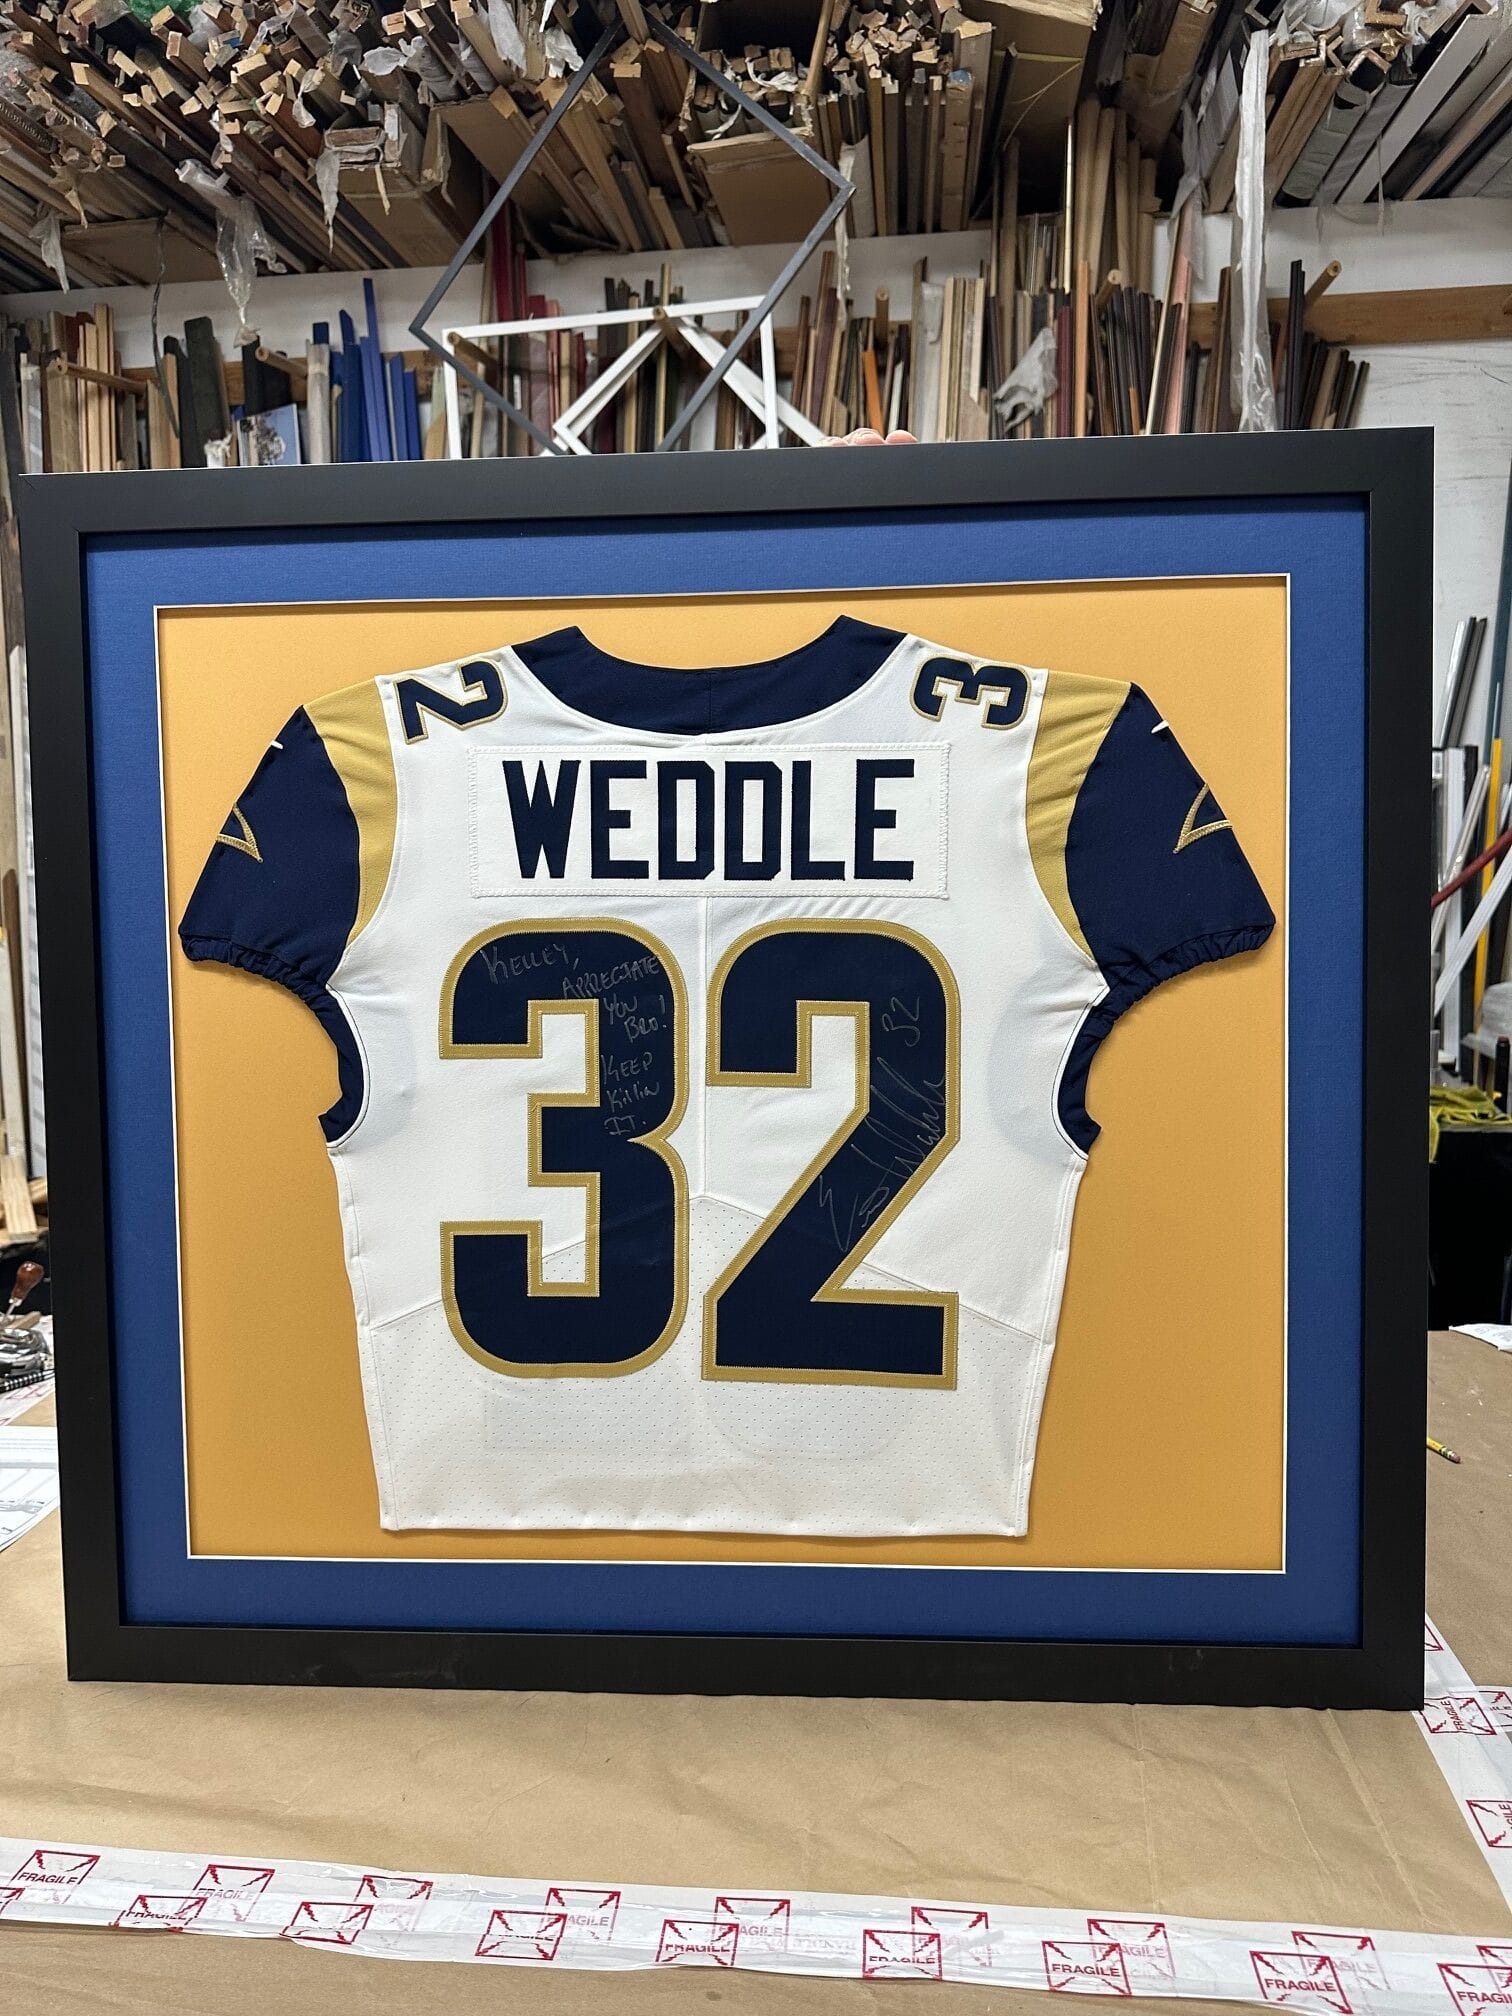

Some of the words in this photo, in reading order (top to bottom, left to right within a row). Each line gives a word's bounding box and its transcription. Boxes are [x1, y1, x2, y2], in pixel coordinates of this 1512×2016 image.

[394, 656, 508, 745] 2
[909, 655, 1031, 731] 3
[501, 758, 915, 882] WEDDLE
[439, 916, 961, 1390] 32
[17, 1871, 79, 1885] FRAGILE
[1052, 1963, 1121, 1977] FRAGILE
[1264, 1978, 1337, 1992] FRAGILE
